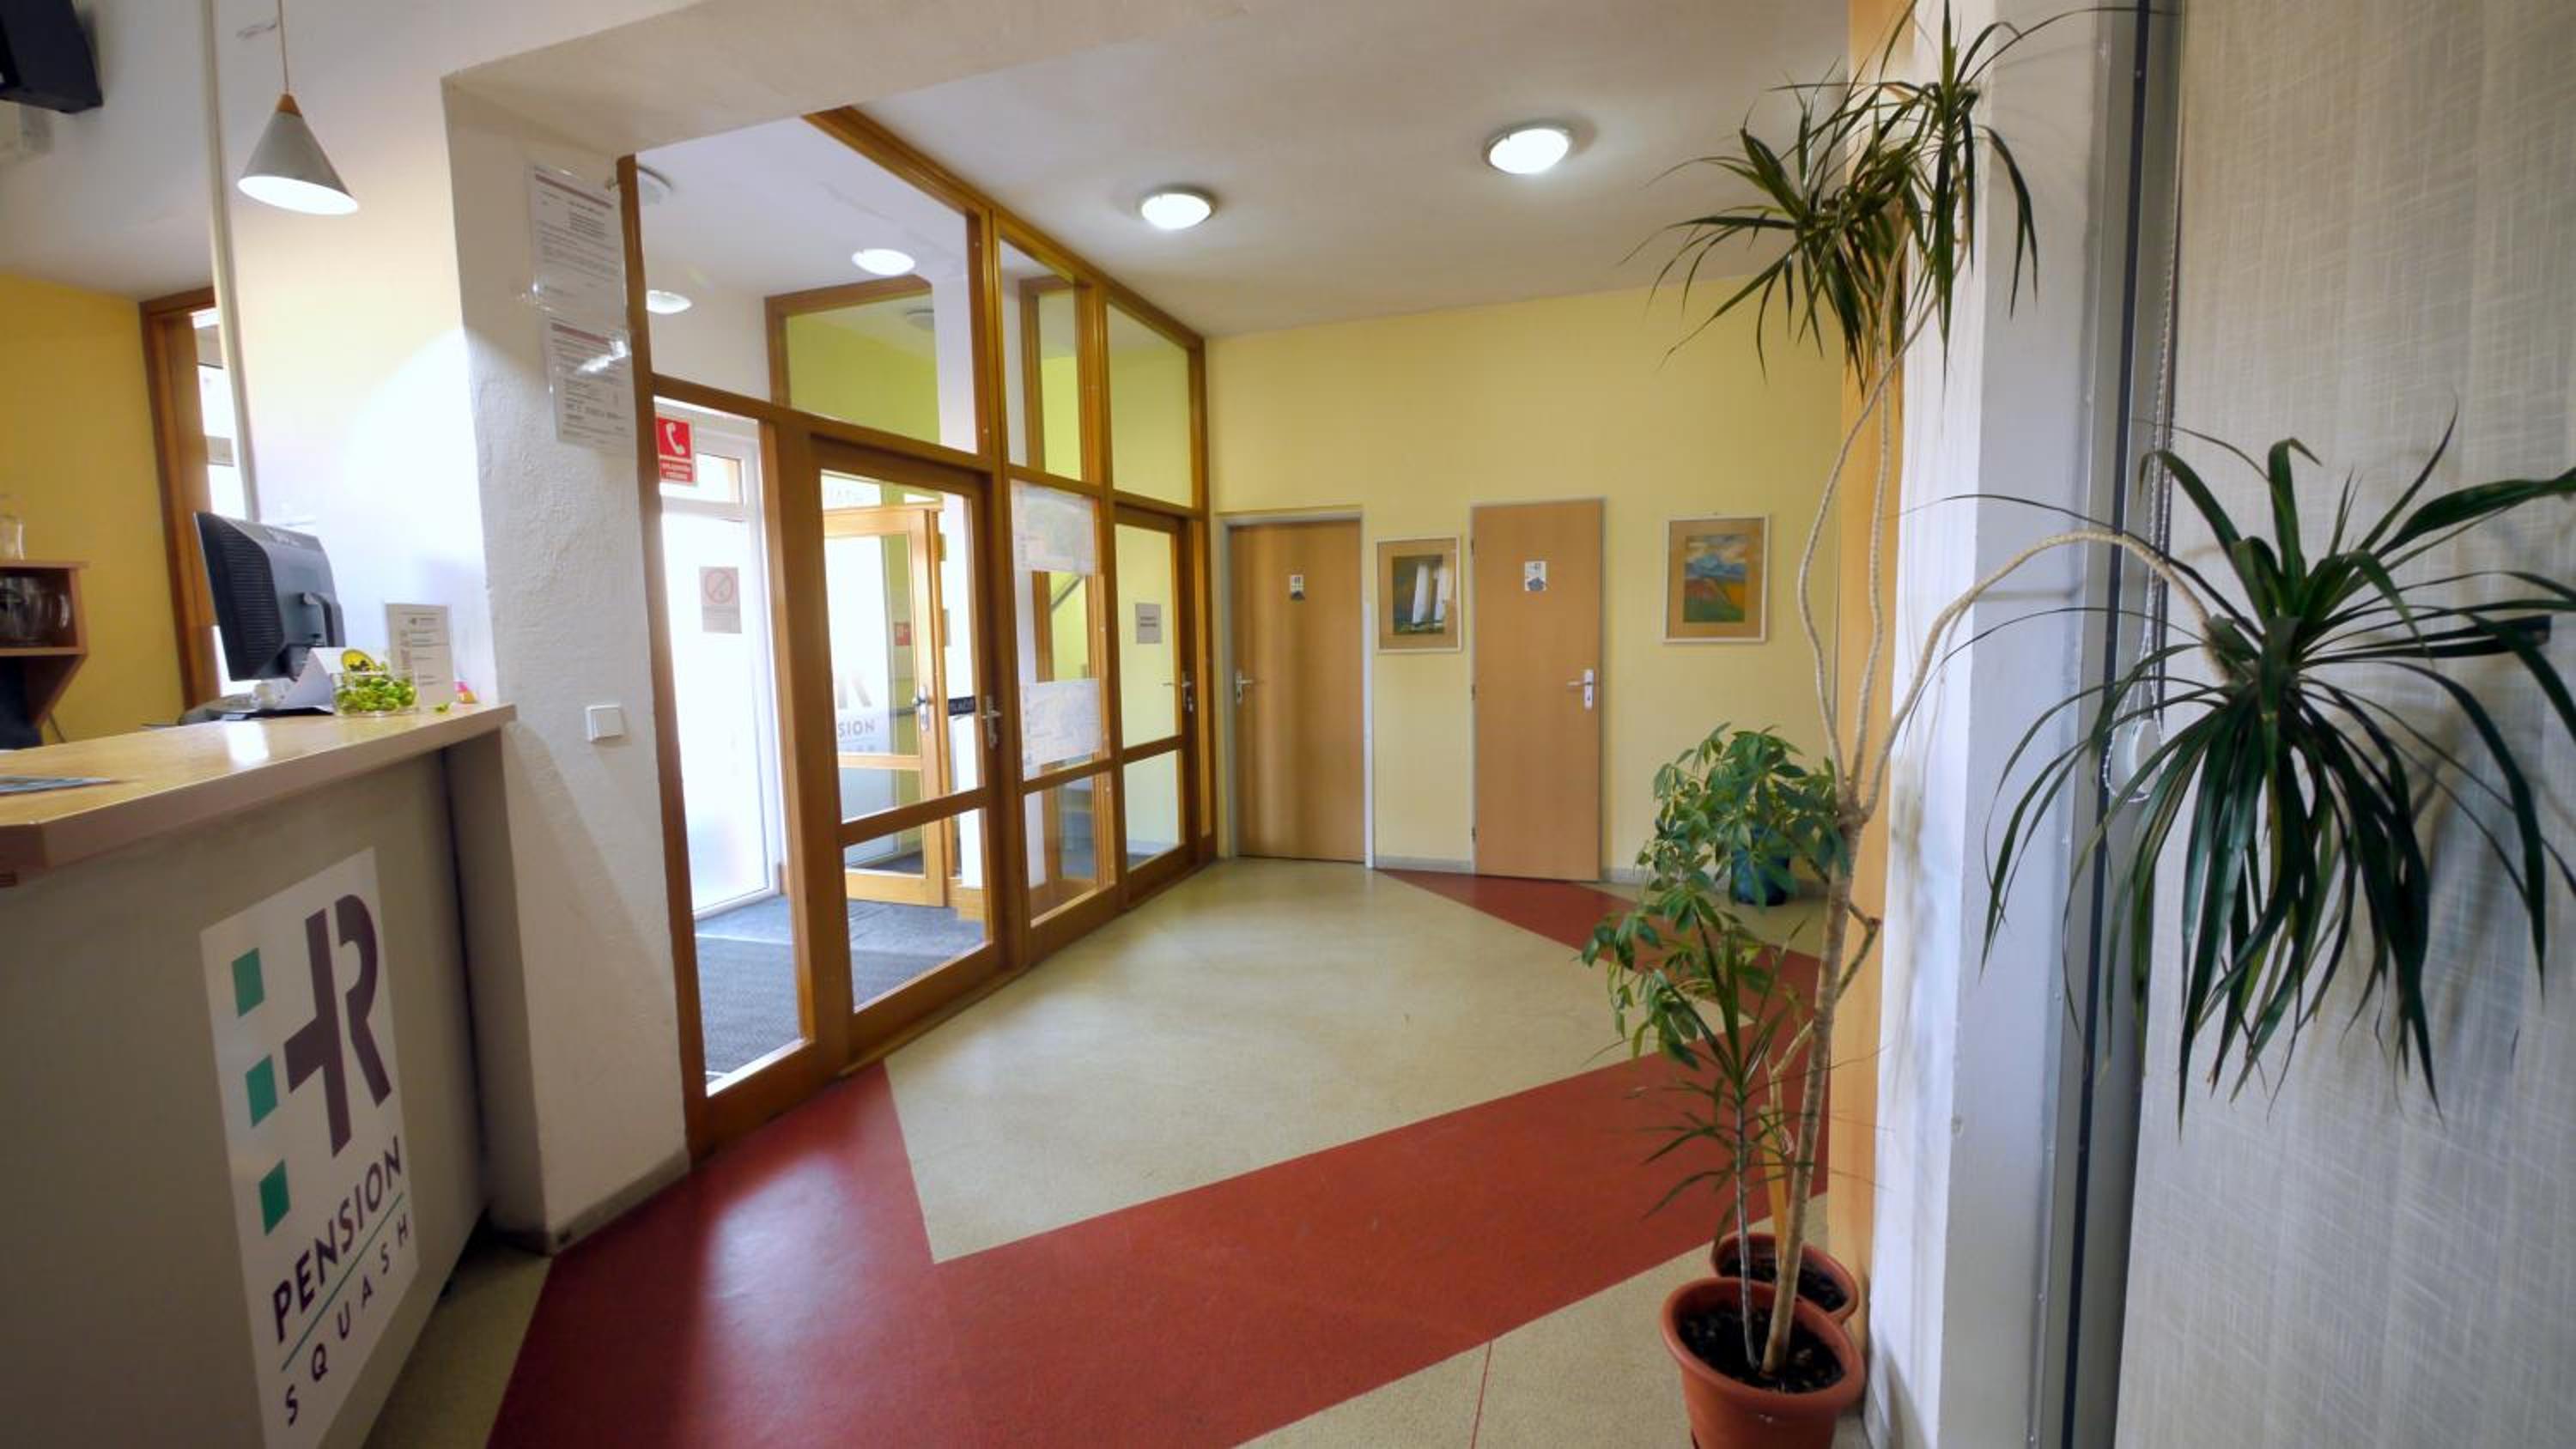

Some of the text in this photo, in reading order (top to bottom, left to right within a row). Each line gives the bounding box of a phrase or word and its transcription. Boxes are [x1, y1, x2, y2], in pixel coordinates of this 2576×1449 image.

[837, 718, 876, 739] SION
[271, 1136, 404, 1344] PENSION
[284, 1210, 410, 1428] SQUASH
